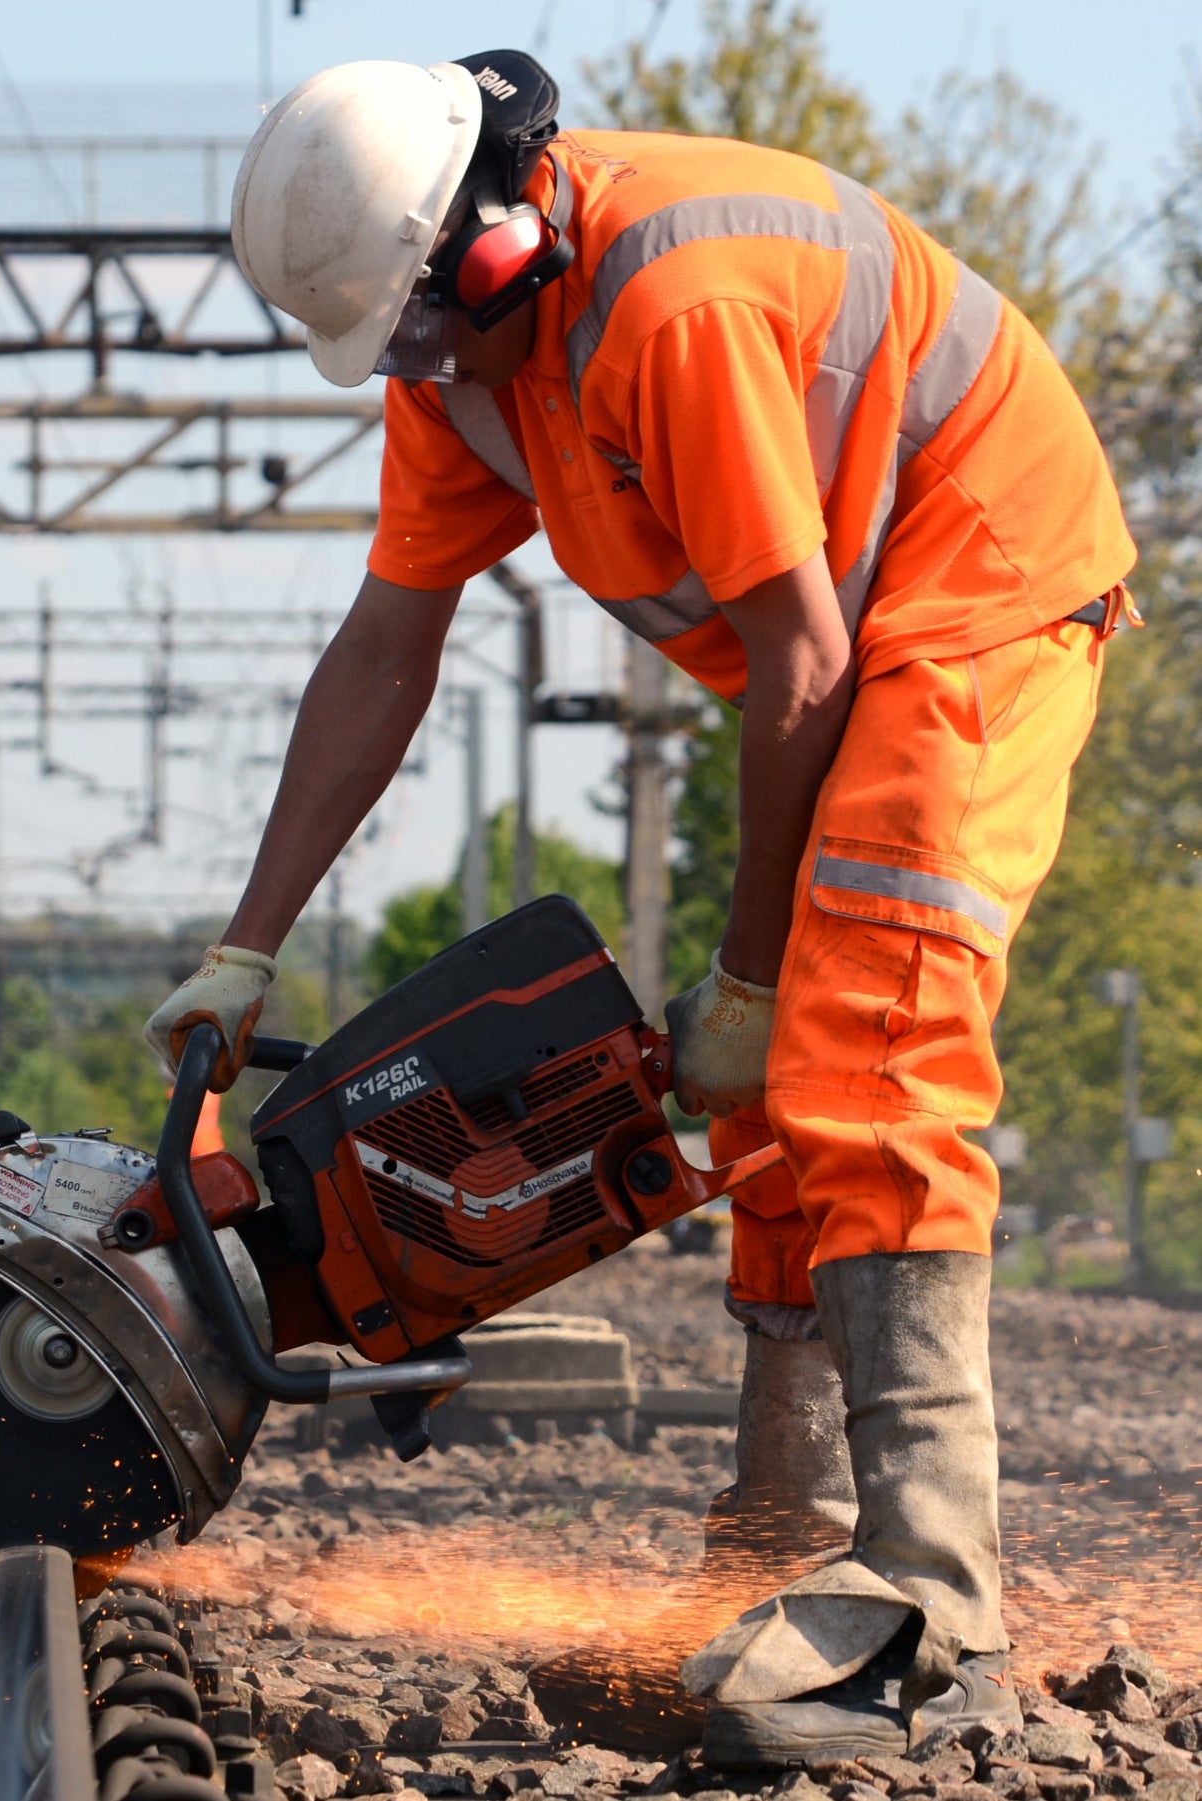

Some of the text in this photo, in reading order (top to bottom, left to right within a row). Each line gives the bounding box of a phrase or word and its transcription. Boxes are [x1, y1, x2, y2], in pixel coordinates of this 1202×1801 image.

[473, 66, 518, 101] uvex
[345, 1056, 419, 1105] K1260
[390, 1075, 427, 1101] RAIL
[0, 1169, 36, 1191] WARNING
[55, 1178, 81, 1192] 5400
[532, 1160, 587, 1193] Husqvarna
